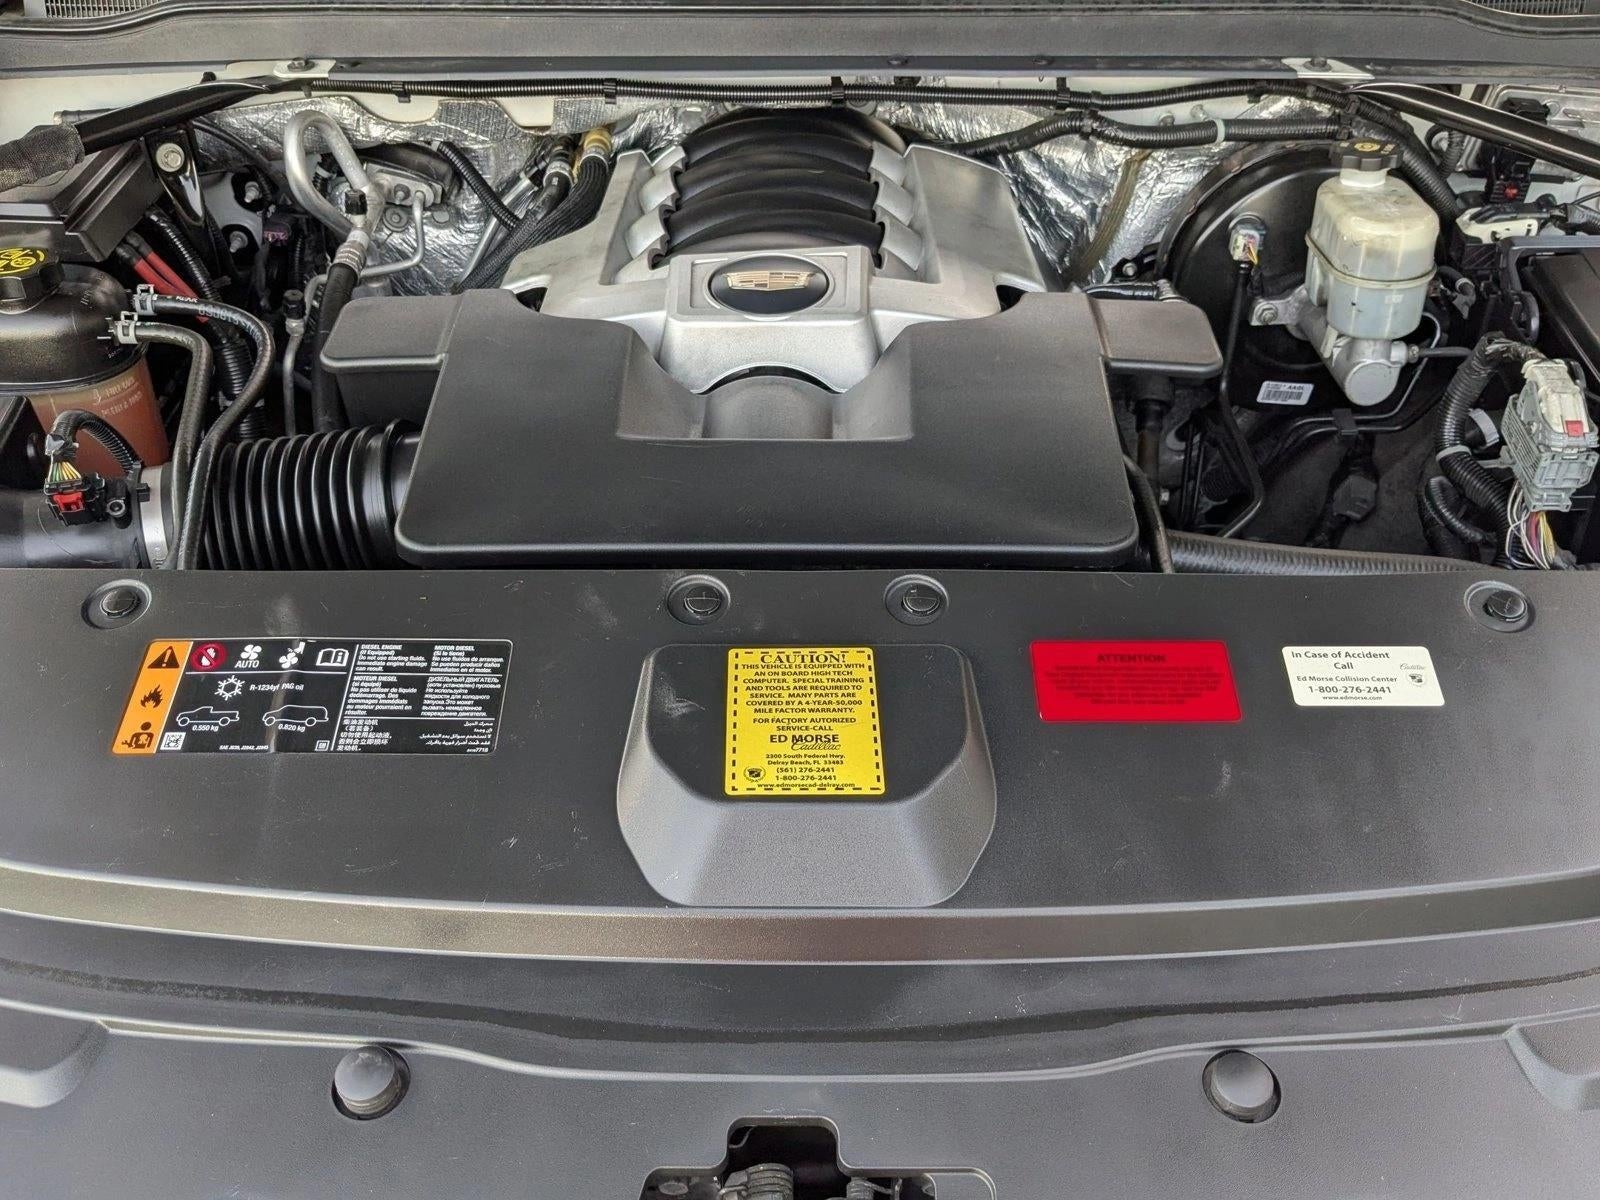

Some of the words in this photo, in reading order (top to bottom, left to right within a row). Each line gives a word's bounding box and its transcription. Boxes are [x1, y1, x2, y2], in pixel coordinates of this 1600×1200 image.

[760, 654, 846, 663] CAUTION!
[1097, 654, 1166, 663] ATTENTION
[1344, 651, 1390, 659] Accident
[235, 660, 259, 668] AUTO
[1334, 662, 1354, 670] Call
[1309, 686, 1392, 694] 1-800-276-2441
[770, 735, 788, 743] ED
[792, 735, 839, 743] MORSE
[791, 738, 841, 751] Cadillac
